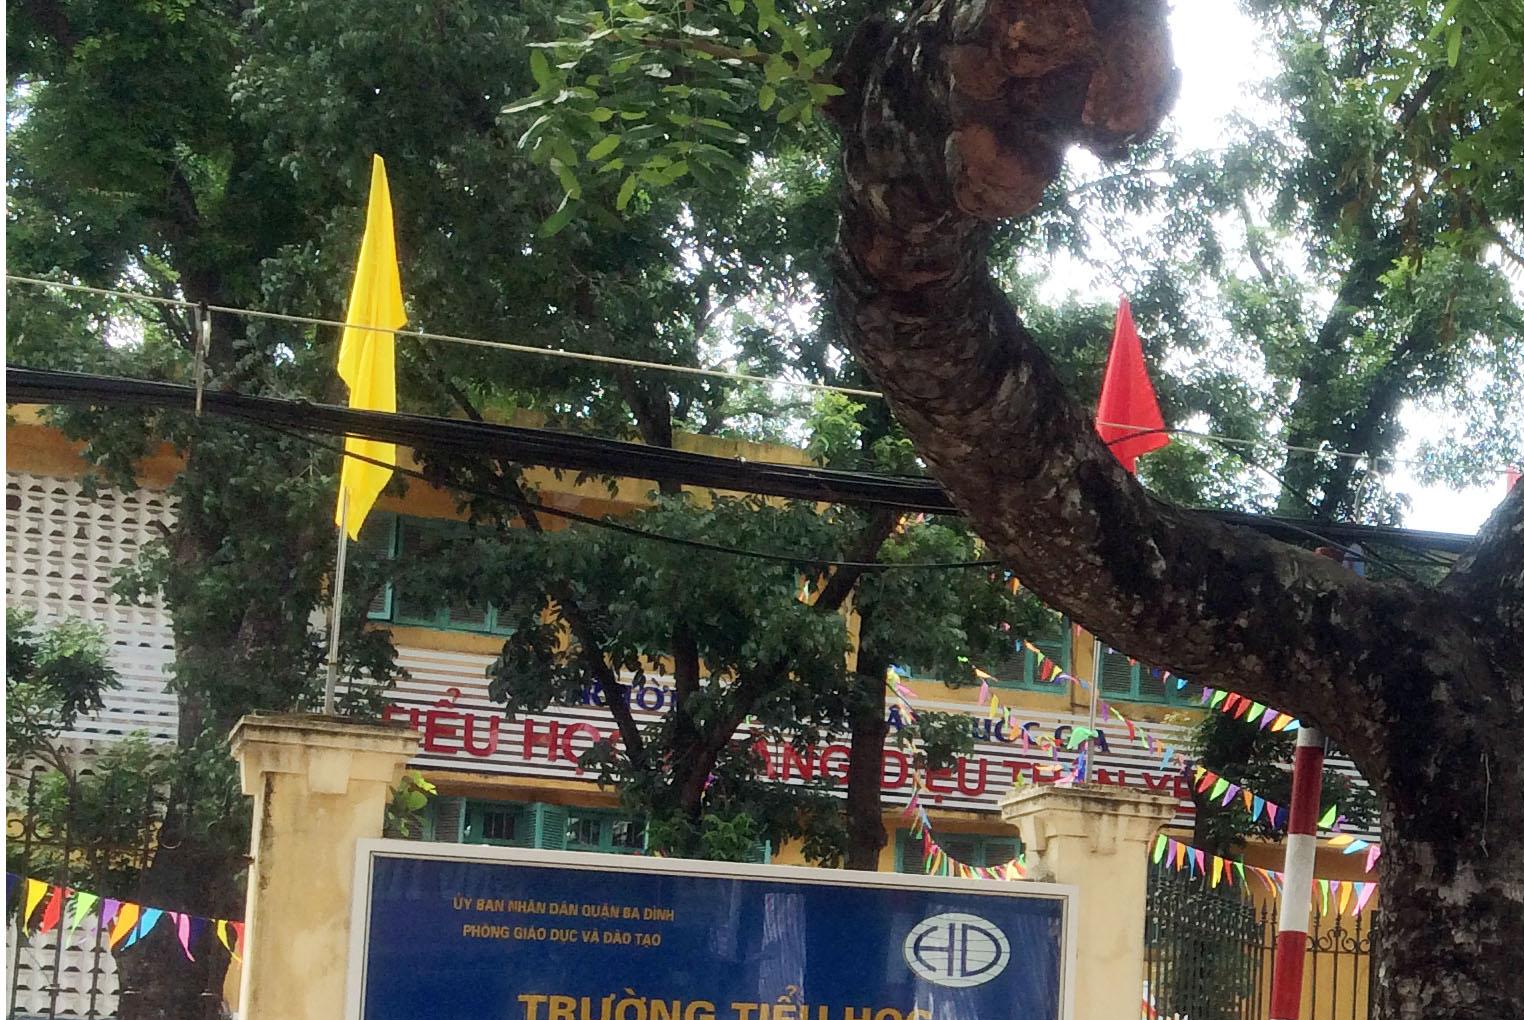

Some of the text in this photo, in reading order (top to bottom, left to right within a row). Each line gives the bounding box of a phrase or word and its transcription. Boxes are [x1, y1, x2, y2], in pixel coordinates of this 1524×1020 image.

[476, 898, 504, 913] BAN
[508, 897, 546, 914] NHÂN
[549, 899, 578, 916] DÂN
[623, 907, 640, 920] BA
[514, 924, 546, 940] GIÁO
[550, 928, 577, 944] DỤC
[635, 933, 662, 948] TẠO
